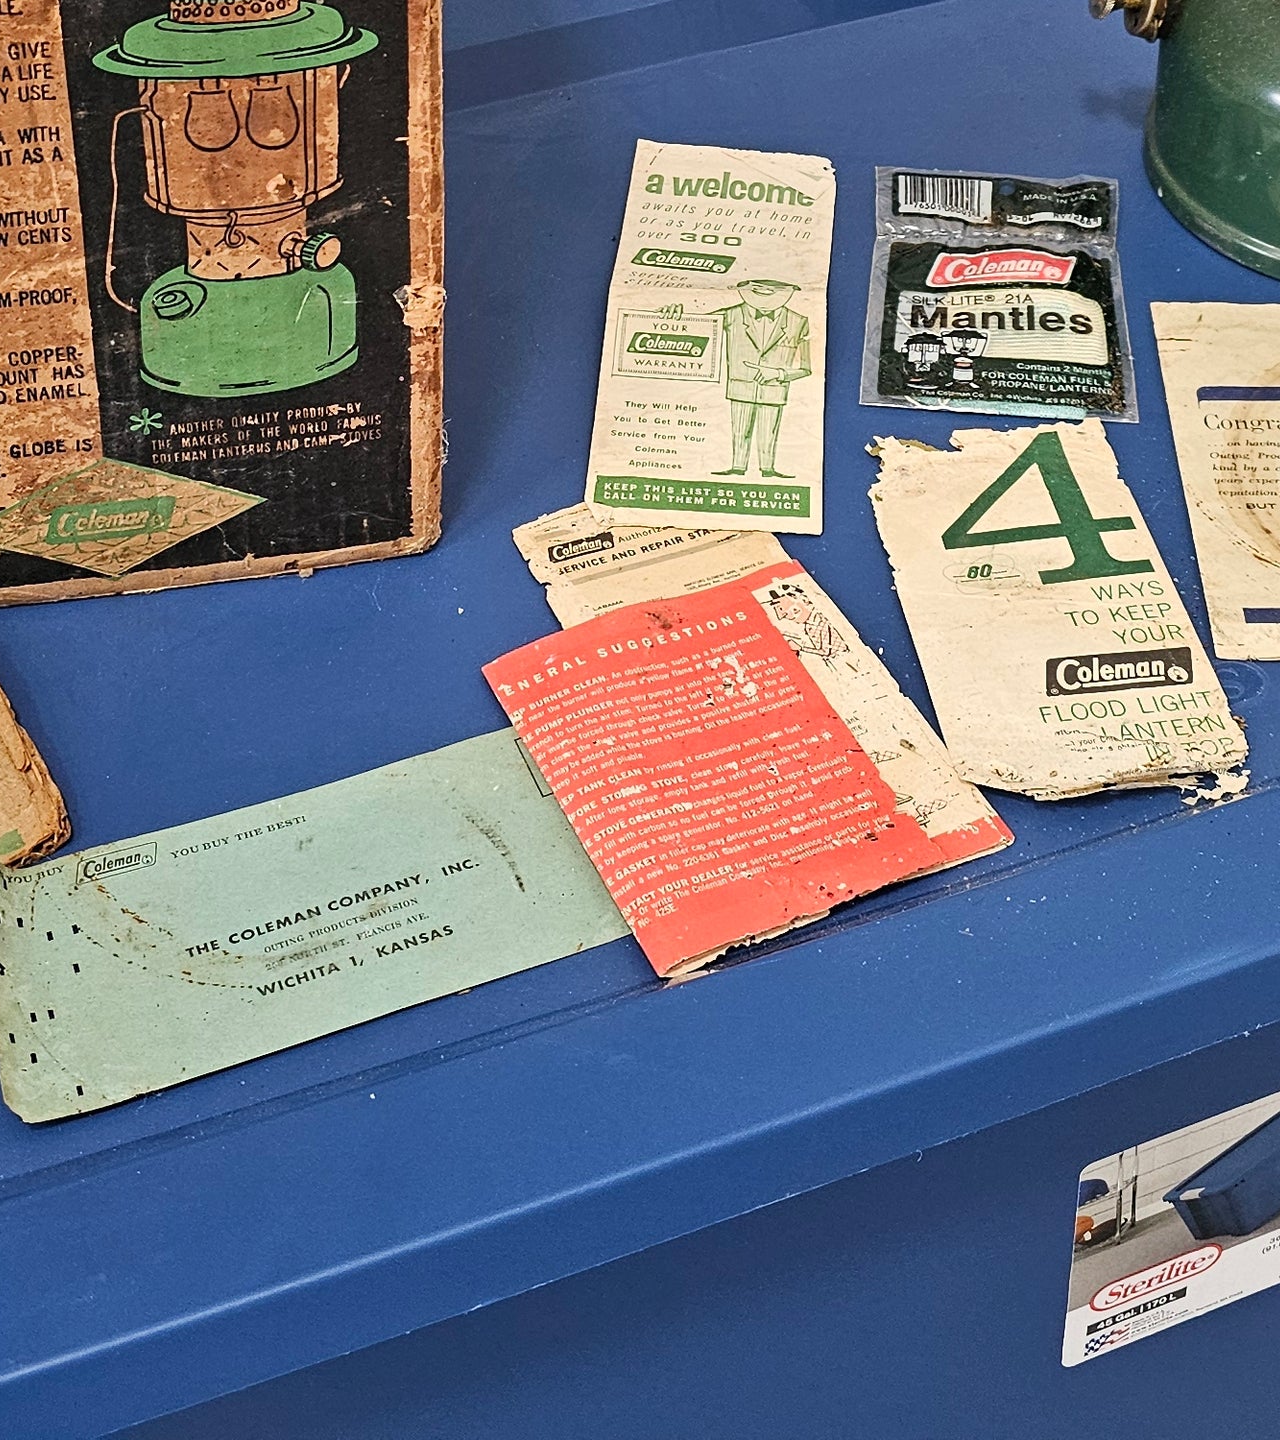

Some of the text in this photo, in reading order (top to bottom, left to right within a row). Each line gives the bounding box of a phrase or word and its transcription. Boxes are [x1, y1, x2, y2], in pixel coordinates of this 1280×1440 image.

[8, 42, 51, 60] GIVE
[1, 66, 13, 82] A
[19, 63, 54, 80] LIFE
[18, 84, 56, 102] USE.
[18, 126, 60, 144] WITH
[22, 148, 44, 164] AS
[51, 147, 63, 162] A
[645, 172, 815, 207] a welcome
[17, 228, 72, 246] CENTS
[638, 229, 742, 246] over 300
[642, 249, 715, 270] Coleman
[944, 258, 1043, 282] Coleman
[1005, 294, 1034, 304] 21A
[652, 322, 688, 332] YOUR
[910, 305, 1093, 334] Mantles
[634, 334, 693, 353] Coleman
[8, 346, 83, 366] COPPER-
[634, 359, 704, 370] WARRANTY
[52, 364, 84, 381] HAS
[16, 383, 91, 403] ENAMEL.
[10, 440, 65, 459] GLOBE
[75, 439, 93, 453] IS
[604, 482, 800, 501] KEEP THIS LIST SO YOU CAN
[604, 492, 801, 511] CALL ON THEM FOR SERVICE
[941, 431, 1155, 584] 4
[56, 509, 153, 536] Coleman
[552, 539, 601, 560] Coleman
[611, 549, 636, 561] AND
[640, 536, 684, 553] REPAIR
[688, 528, 715, 540] STA
[1090, 581, 1164, 601] WAYS
[1064, 602, 1172, 628] TO KEEP
[596, 612, 748, 659] SUGGESTIONS
[1112, 624, 1184, 644] YOUR
[1056, 658, 1165, 691] Coleman
[1039, 691, 1212, 723] FLOOD LIGHT
[7, 815, 307, 883] YOU BUY Coleman YOU BUY THE BEST!
[185, 859, 480, 958] THE COLEMAN COMPANY, INC.
[264, 898, 418, 953] OUTING PRODUCTS DIVISION
[256, 963, 341, 997] WICHITA
[375, 925, 454, 957] KANSAS
[1105, 1256, 1207, 1305] Sterilite
[1096, 1319, 1114, 1330] 45
[1115, 1309, 1138, 1322] Gal.
[1146, 1297, 1167, 1309] 170
